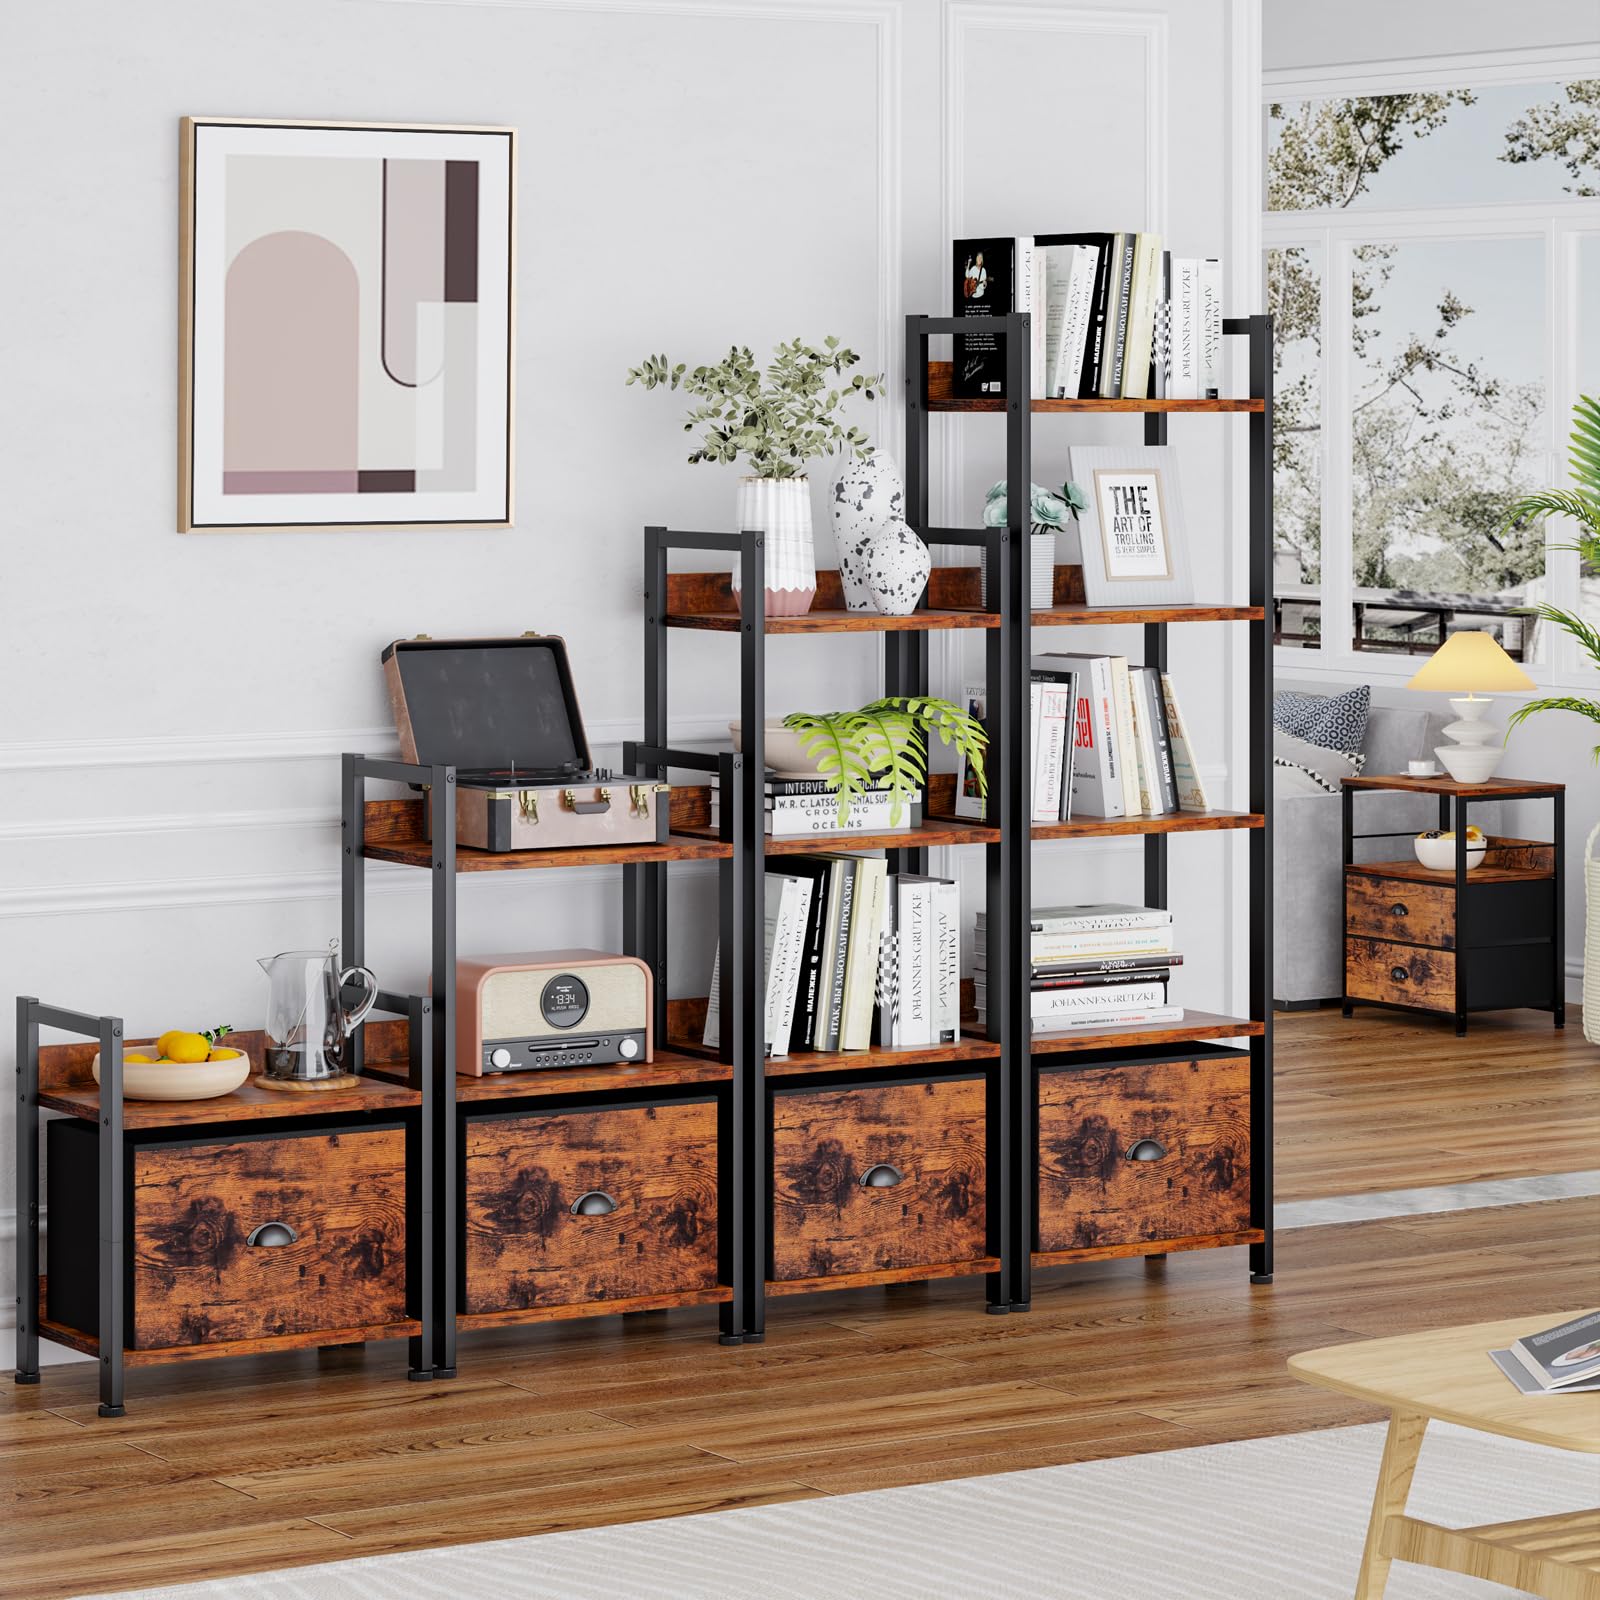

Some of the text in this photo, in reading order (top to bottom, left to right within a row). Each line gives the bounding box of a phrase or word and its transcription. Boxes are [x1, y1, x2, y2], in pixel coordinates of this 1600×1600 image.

[1108, 485, 1151, 515] THE
[1113, 516, 1152, 533] ART OF
[1115, 533, 1154, 545] TROLLING
[1123, 546, 1136, 554] VERY
[1137, 545, 1157, 553] SIMPLE
[778, 800, 788, 809] W.
[790, 799, 798, 808] R.
[800, 799, 808, 808] C.
[812, 820, 862, 830] OCENS
[840, 875, 853, 931] ПРОКАЗОЙ
[835, 933, 848, 987] ЗАБОЛЕЛИ
[832, 988, 842, 1004] ВЫ
